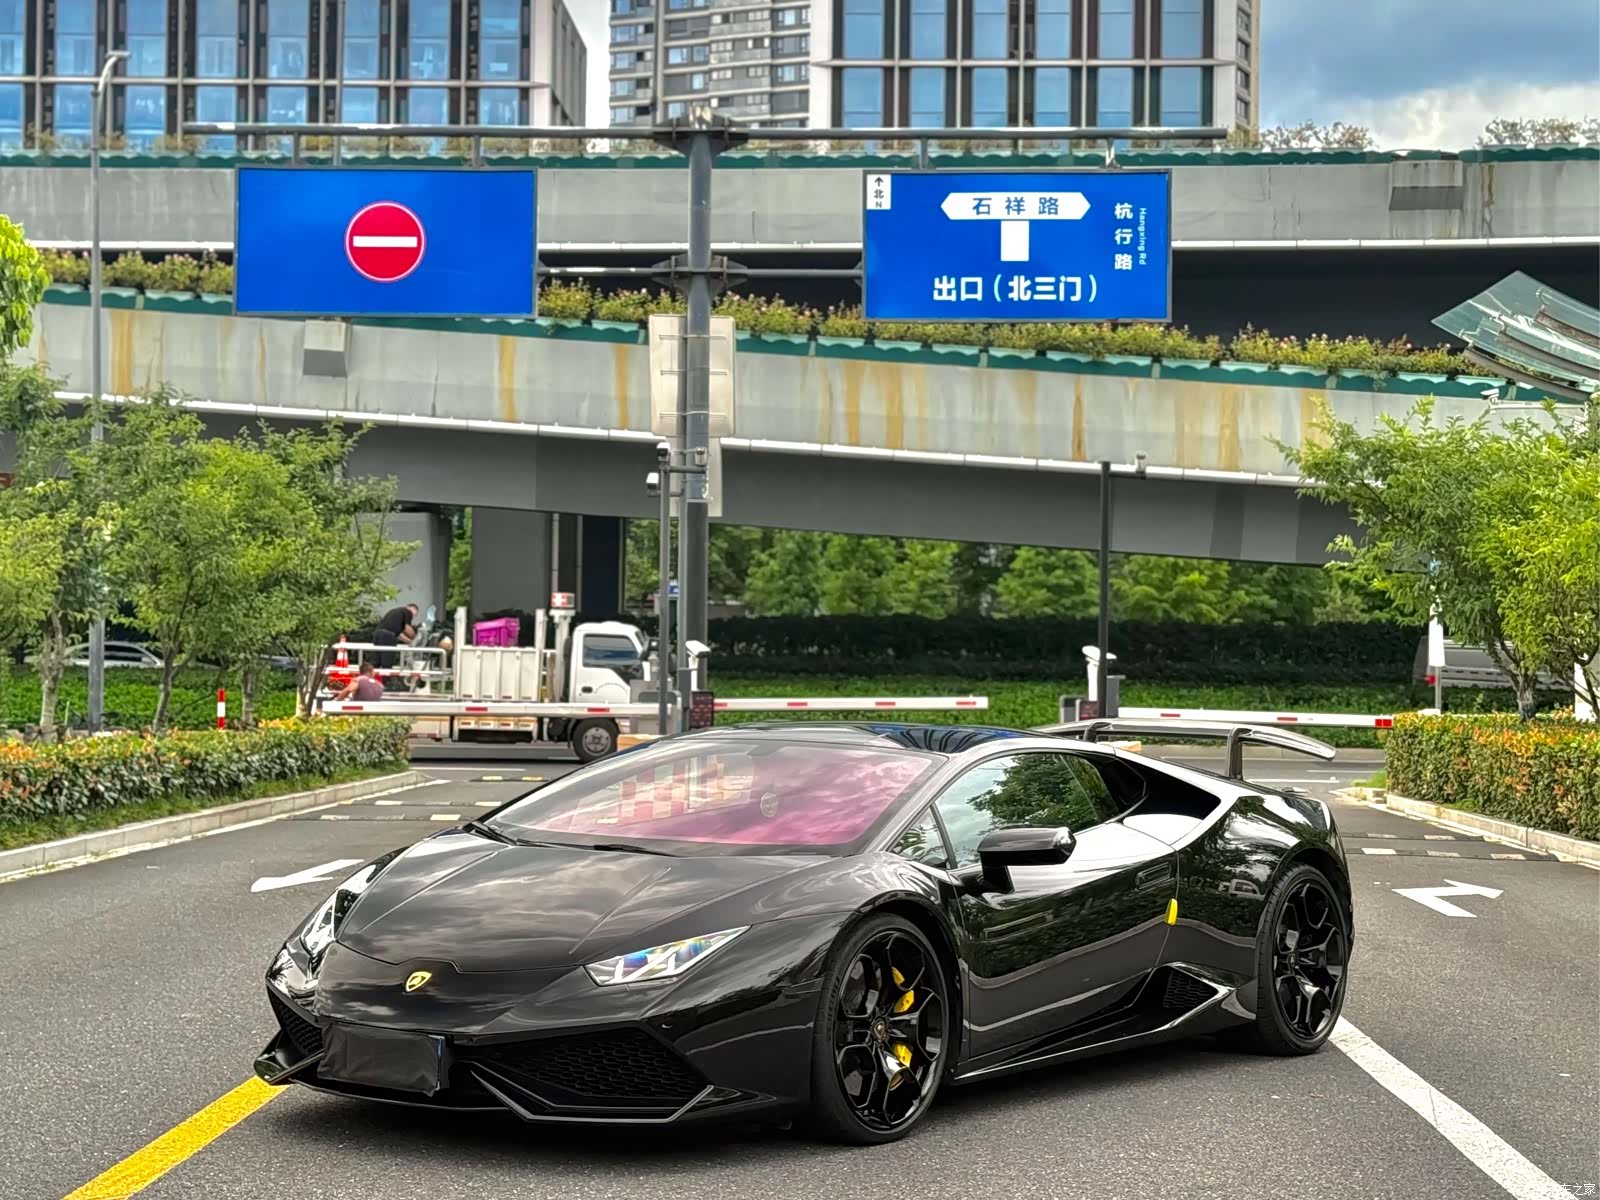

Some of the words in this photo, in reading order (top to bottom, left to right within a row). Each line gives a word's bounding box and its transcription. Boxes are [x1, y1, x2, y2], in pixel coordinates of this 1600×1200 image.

[873, 188, 884, 199] 北
[972, 196, 1059, 216] 石祥路
[1114, 202, 1133, 270] 杭行路
[1137, 207, 1147, 251] Hangxing
[1138, 252, 1147, 265] Rd
